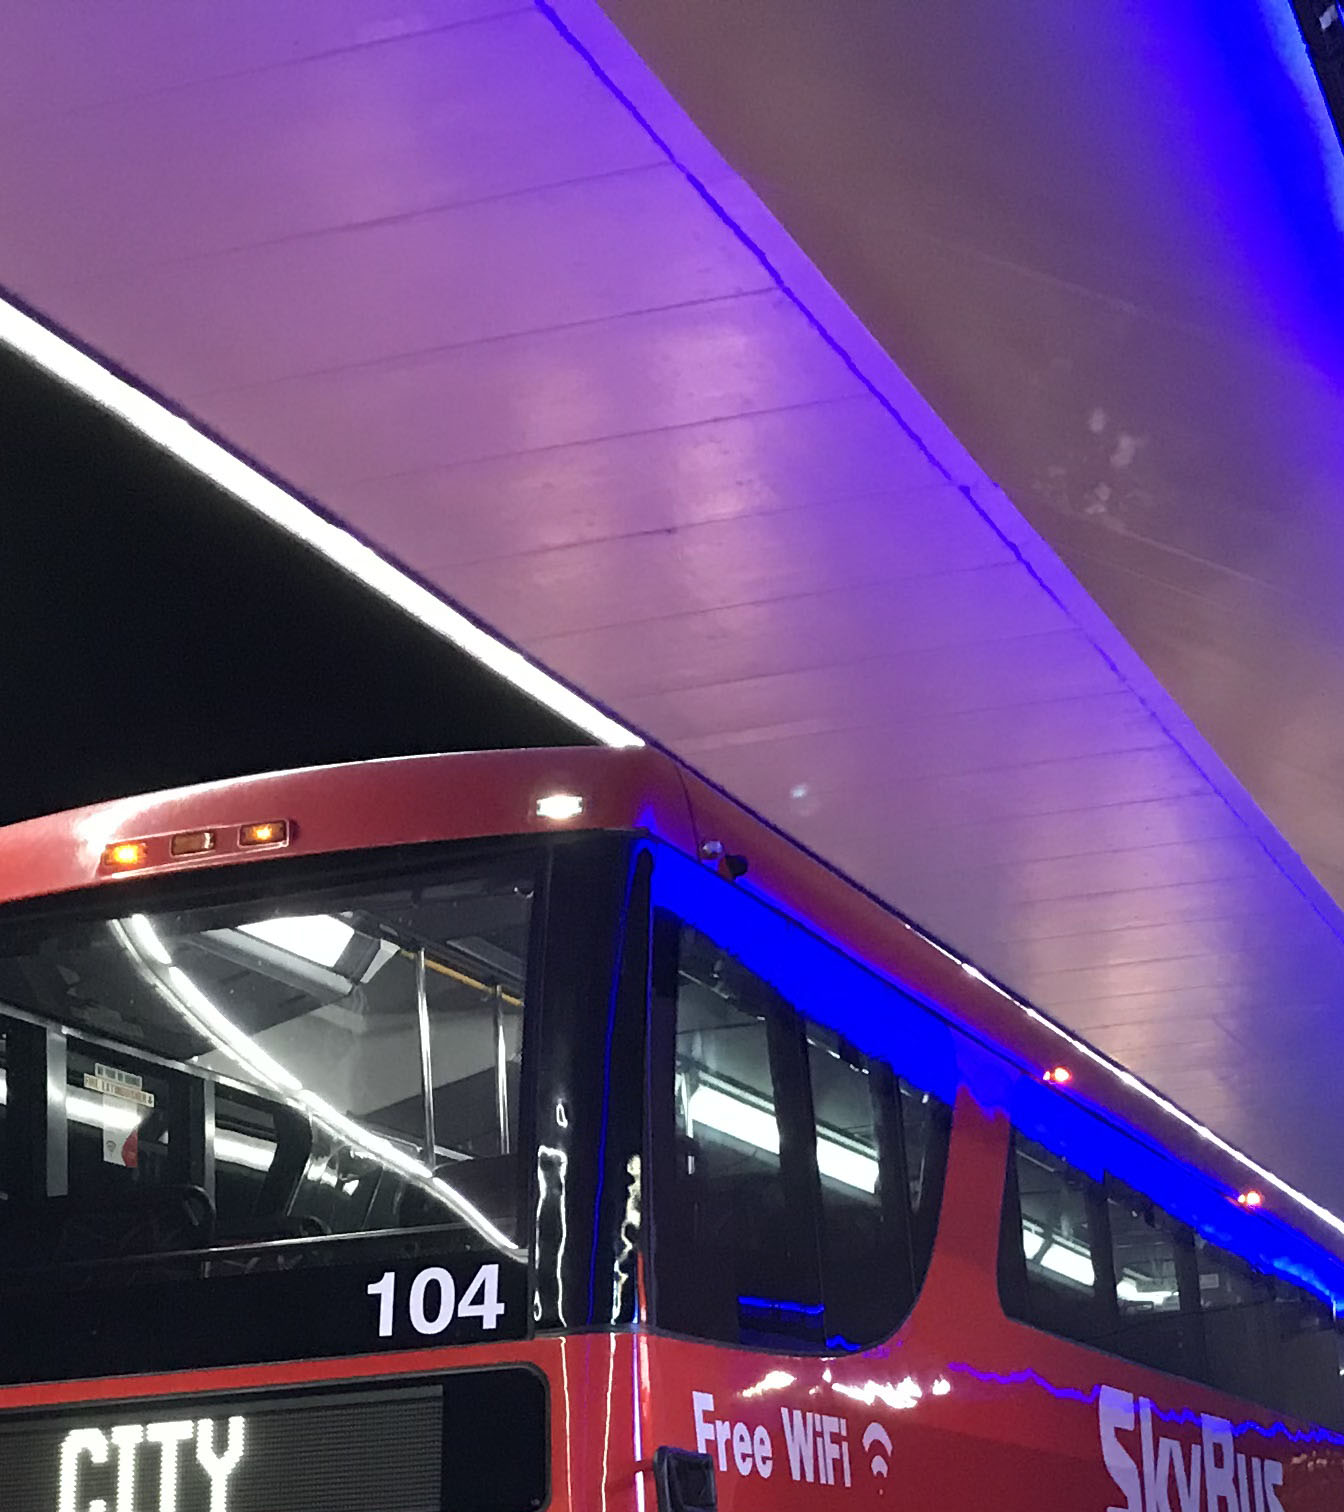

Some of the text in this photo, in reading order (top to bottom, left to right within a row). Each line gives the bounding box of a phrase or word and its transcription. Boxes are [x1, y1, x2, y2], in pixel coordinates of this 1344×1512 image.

[365, 1264, 506, 1338] 104
[692, 1391, 851, 1487] Free WiFi
